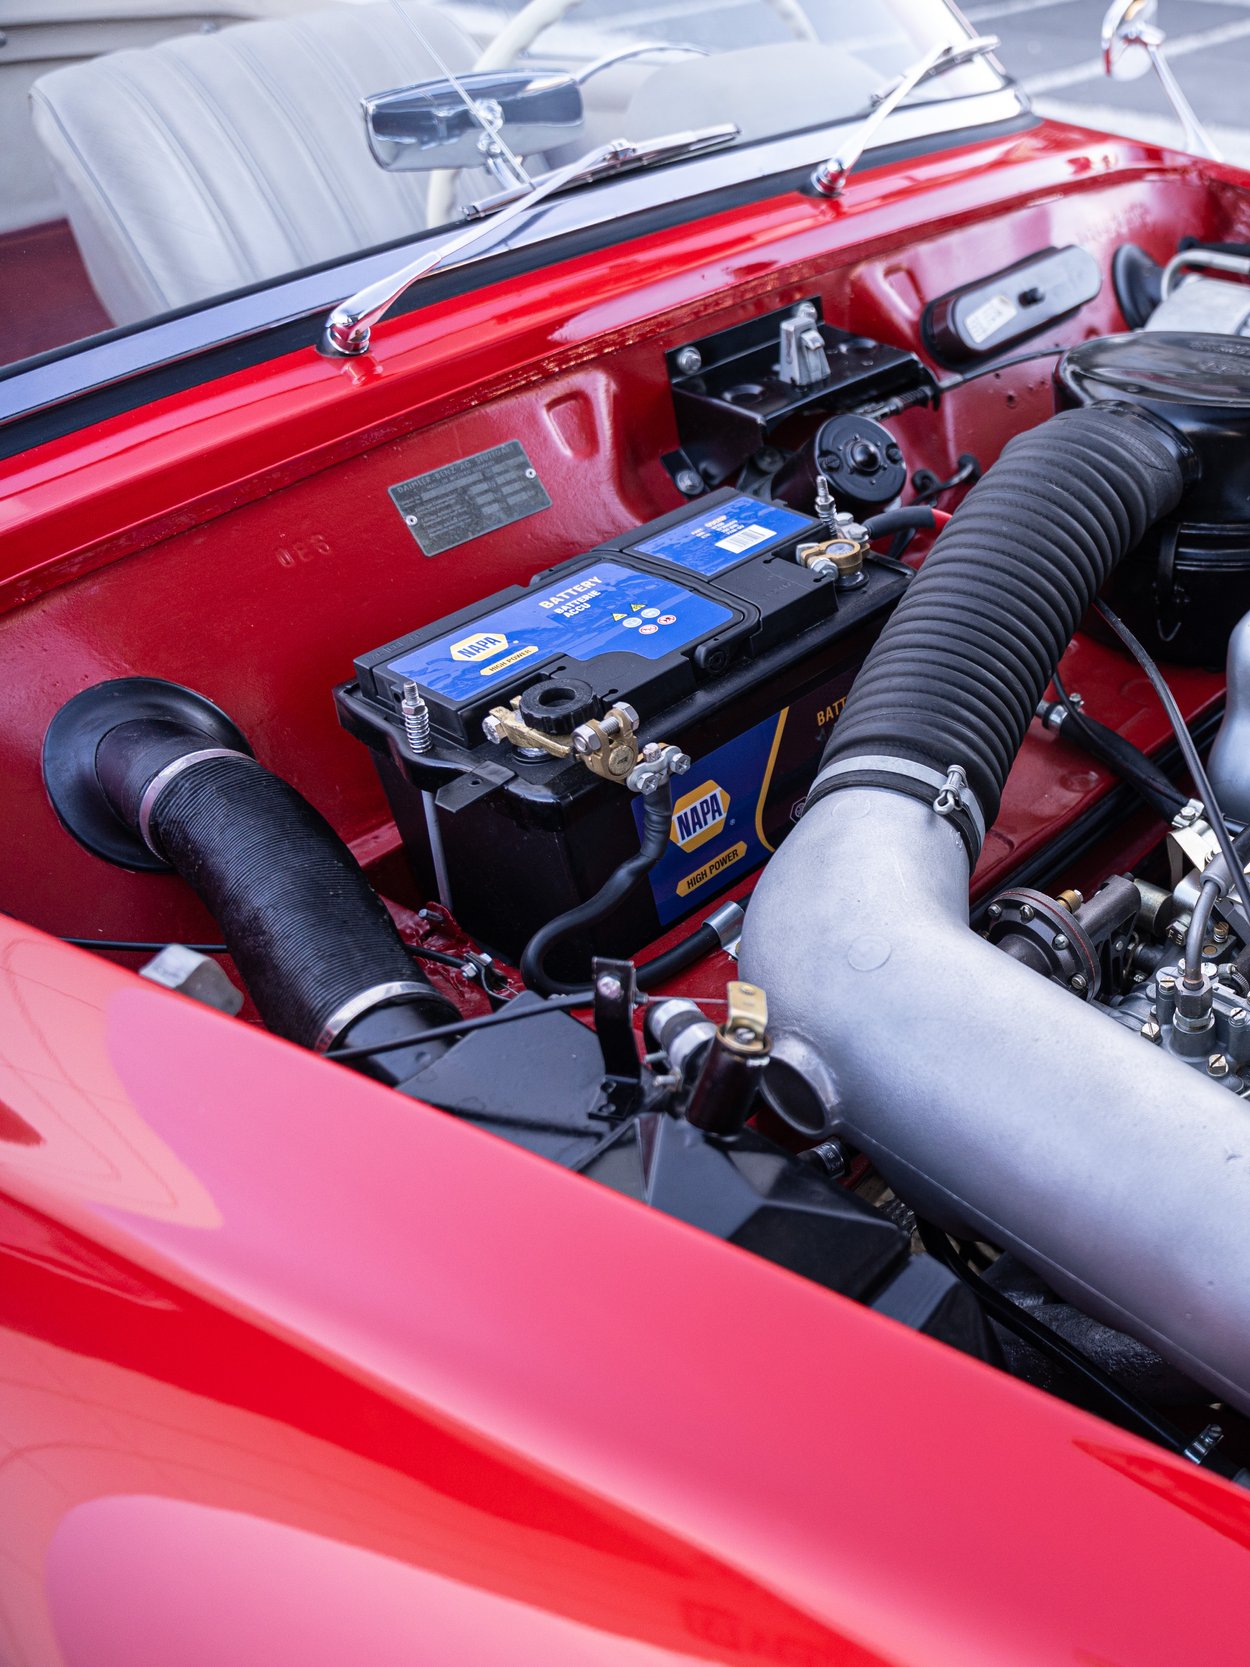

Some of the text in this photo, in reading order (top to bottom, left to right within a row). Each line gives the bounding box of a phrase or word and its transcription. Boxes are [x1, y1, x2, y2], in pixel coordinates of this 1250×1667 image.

[460, 461, 472, 471] AG
[538, 576, 602, 609] BATTERY
[553, 590, 602, 614] BATTERIE
[563, 602, 592, 618] ACCU
[457, 636, 503, 658] NAPA
[488, 649, 532, 672] HIGH POWER
[676, 792, 723, 842] NAPA
[686, 848, 739, 890] HIGH POWER
